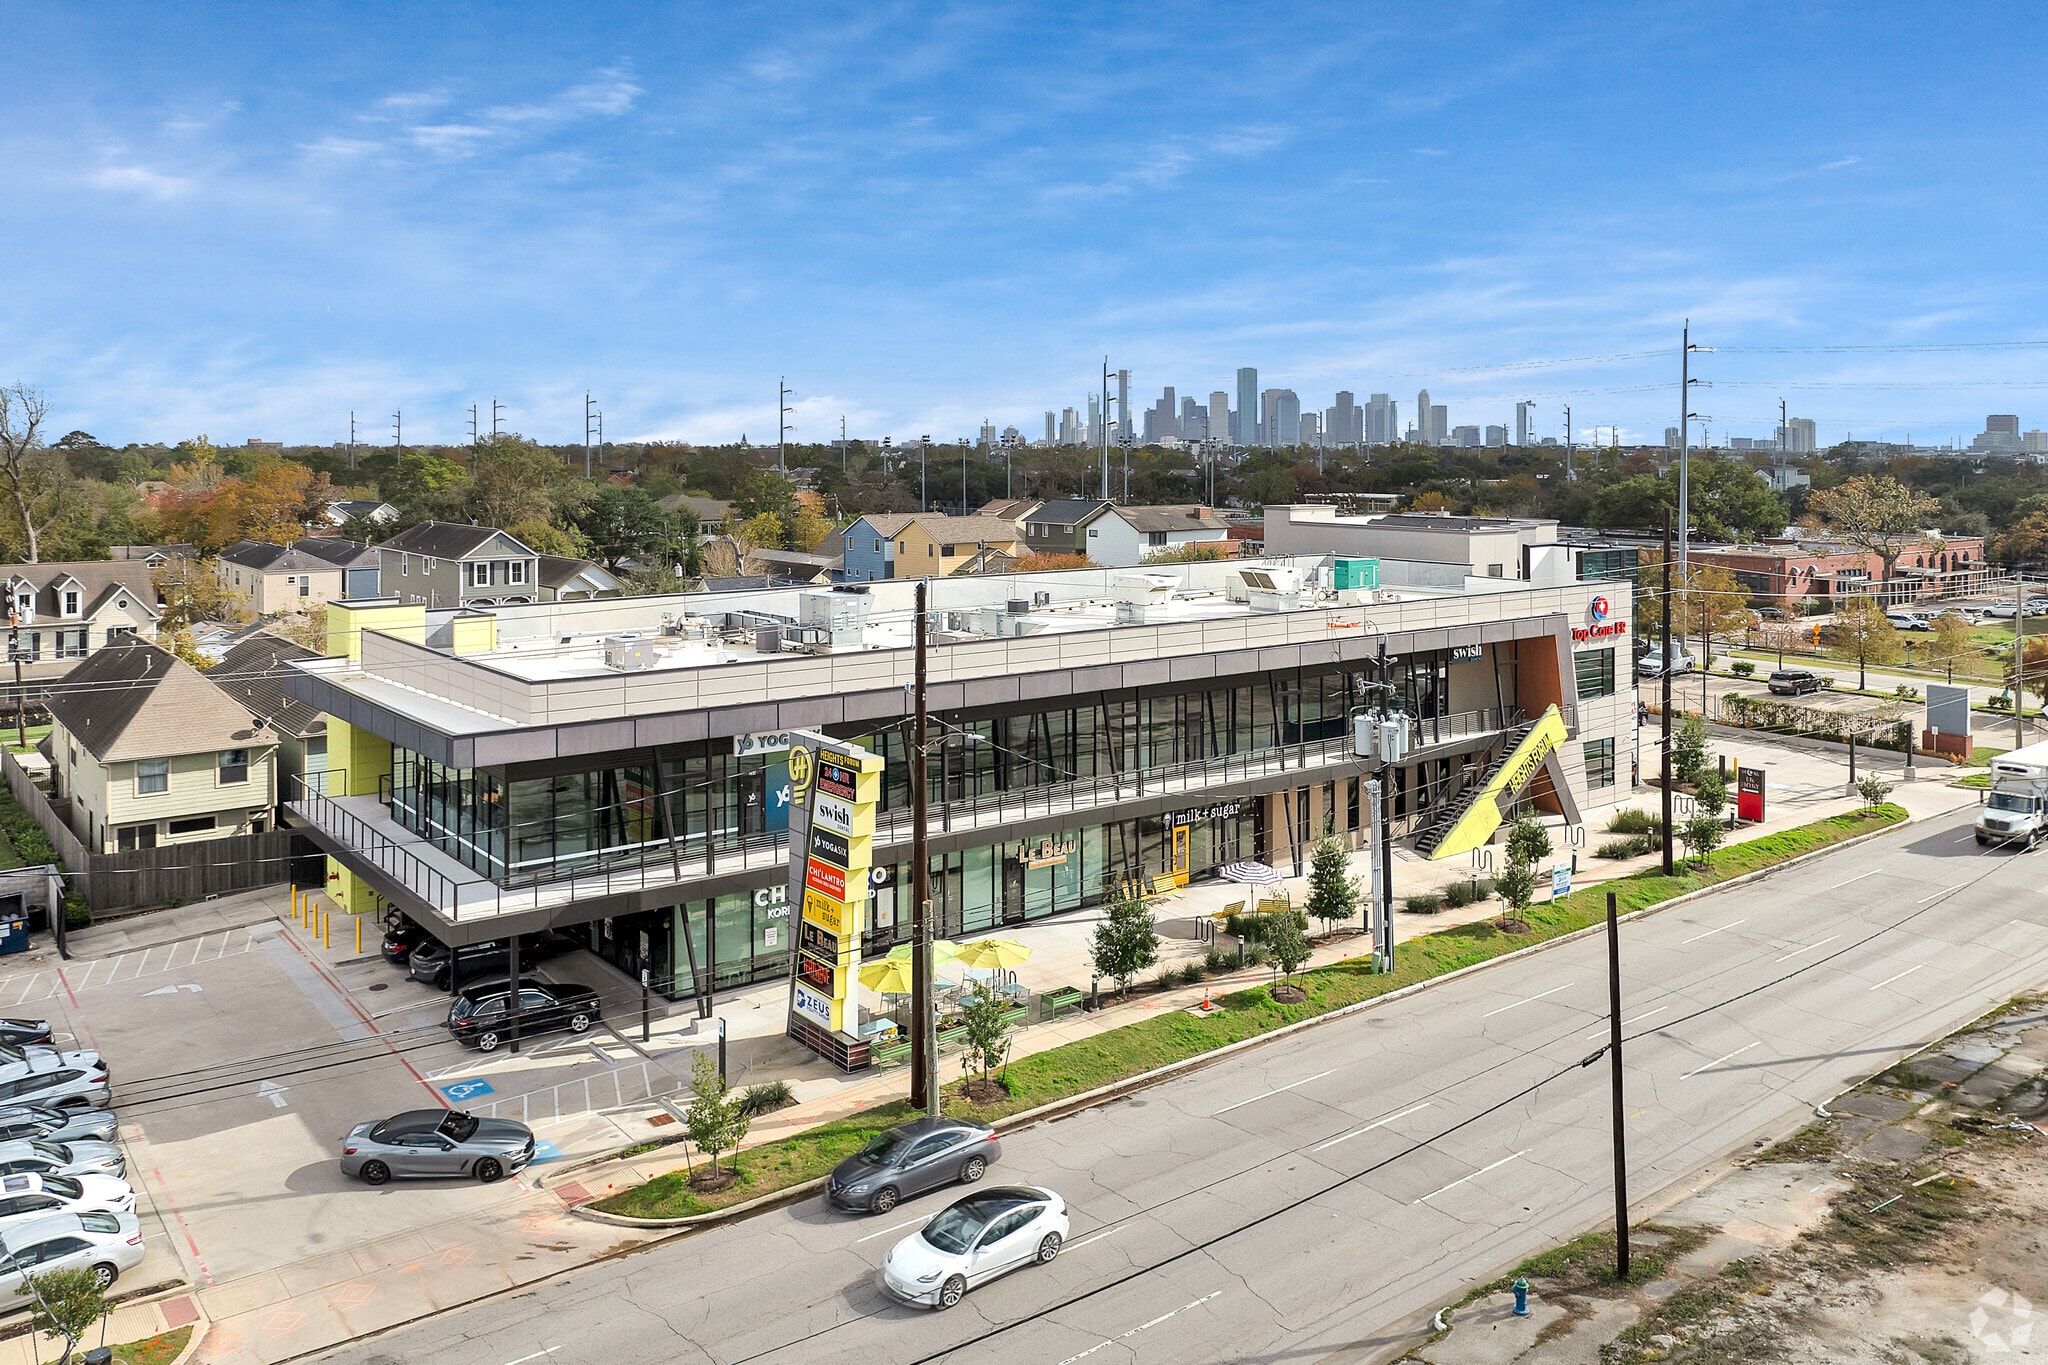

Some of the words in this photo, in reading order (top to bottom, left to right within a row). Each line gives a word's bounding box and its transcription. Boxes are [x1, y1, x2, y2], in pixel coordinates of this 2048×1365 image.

[1571, 627, 1589, 642] Top
[1590, 624, 1614, 638] Care
[1615, 621, 1626, 635] ER
[1453, 644, 1482, 660] swish
[820, 749, 844, 766] HEIGHTS
[843, 756, 860, 768] FORUM
[823, 766, 832, 778] 24
[839, 771, 850, 784] HR
[819, 777, 855, 800] EMERGENCY
[819, 804, 850, 827] swish
[1175, 809, 1201, 825] milk
[1211, 803, 1241, 819] sugar
[821, 839, 848, 858] YOGASIX
[809, 866, 845, 888] CHI'LANTRO
[816, 899, 831, 912] milk
[822, 912, 840, 927] sugar
[806, 995, 830, 1017] ZEUS
